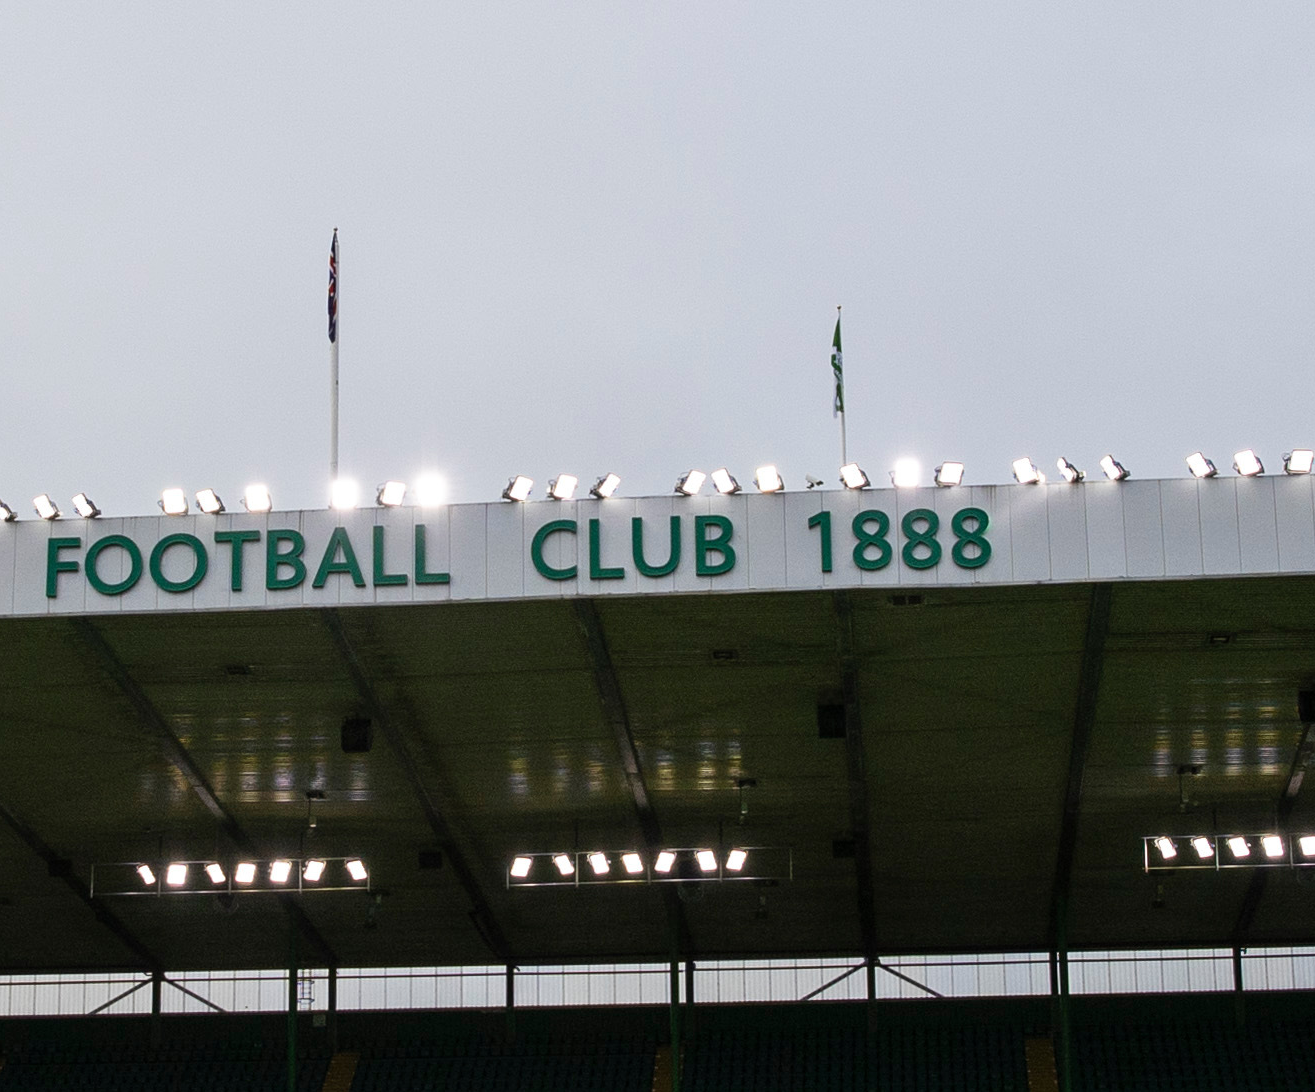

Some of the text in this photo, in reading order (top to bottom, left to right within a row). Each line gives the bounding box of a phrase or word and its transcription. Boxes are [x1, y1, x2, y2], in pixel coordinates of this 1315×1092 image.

[46, 524, 450, 599] FOOTBALL
[530, 514, 737, 581] CLUB
[808, 507, 992, 572] 1888
